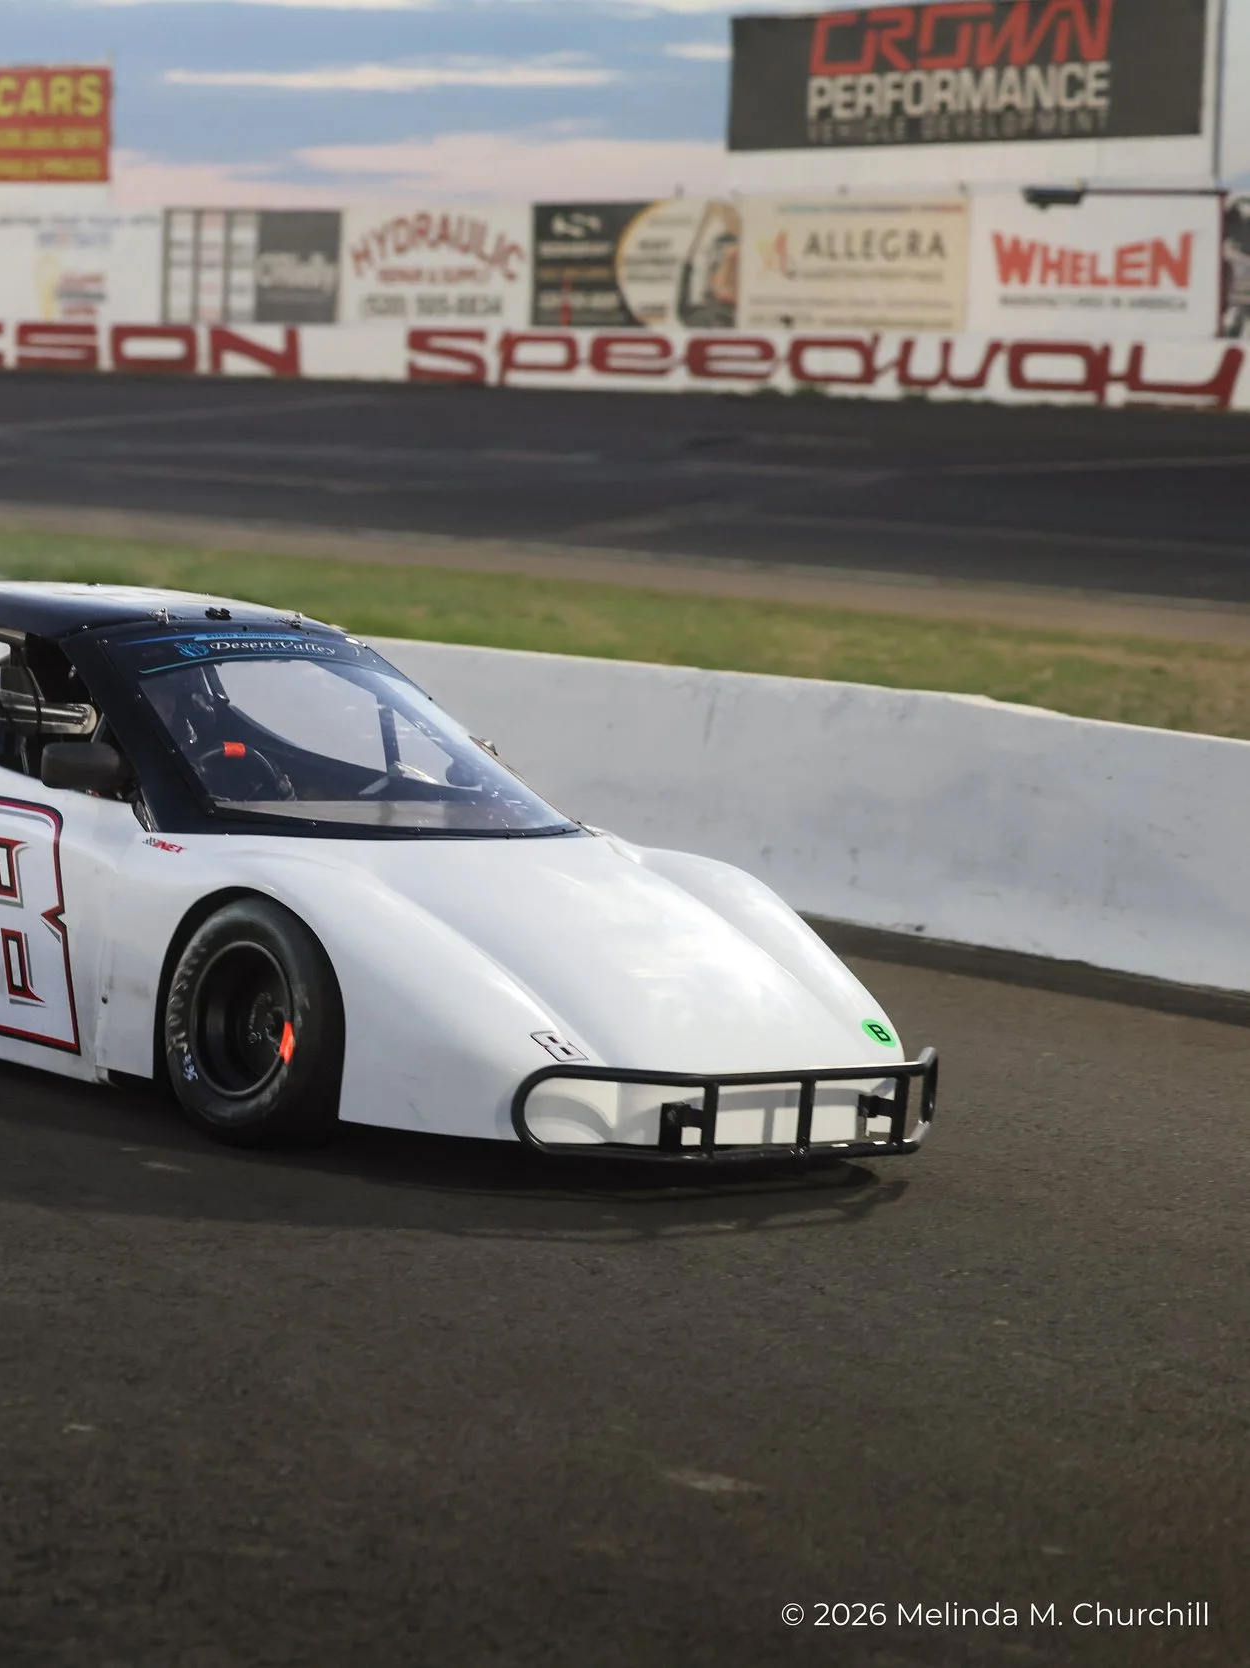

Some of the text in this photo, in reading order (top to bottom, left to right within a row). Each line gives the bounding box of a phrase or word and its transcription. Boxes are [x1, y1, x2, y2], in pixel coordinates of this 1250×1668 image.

[809, 0, 1113, 76] CROWN
[806, 61, 1111, 120] PERFORMANCE
[351, 212, 526, 282] HYDRAULIC
[803, 228, 947, 263] ALLEGRA
[991, 230, 1194, 289] WHELEN
[210, 640, 273, 651] Desert
[529, 1030, 589, 1062] 8
[867, 1024, 892, 1042] B
